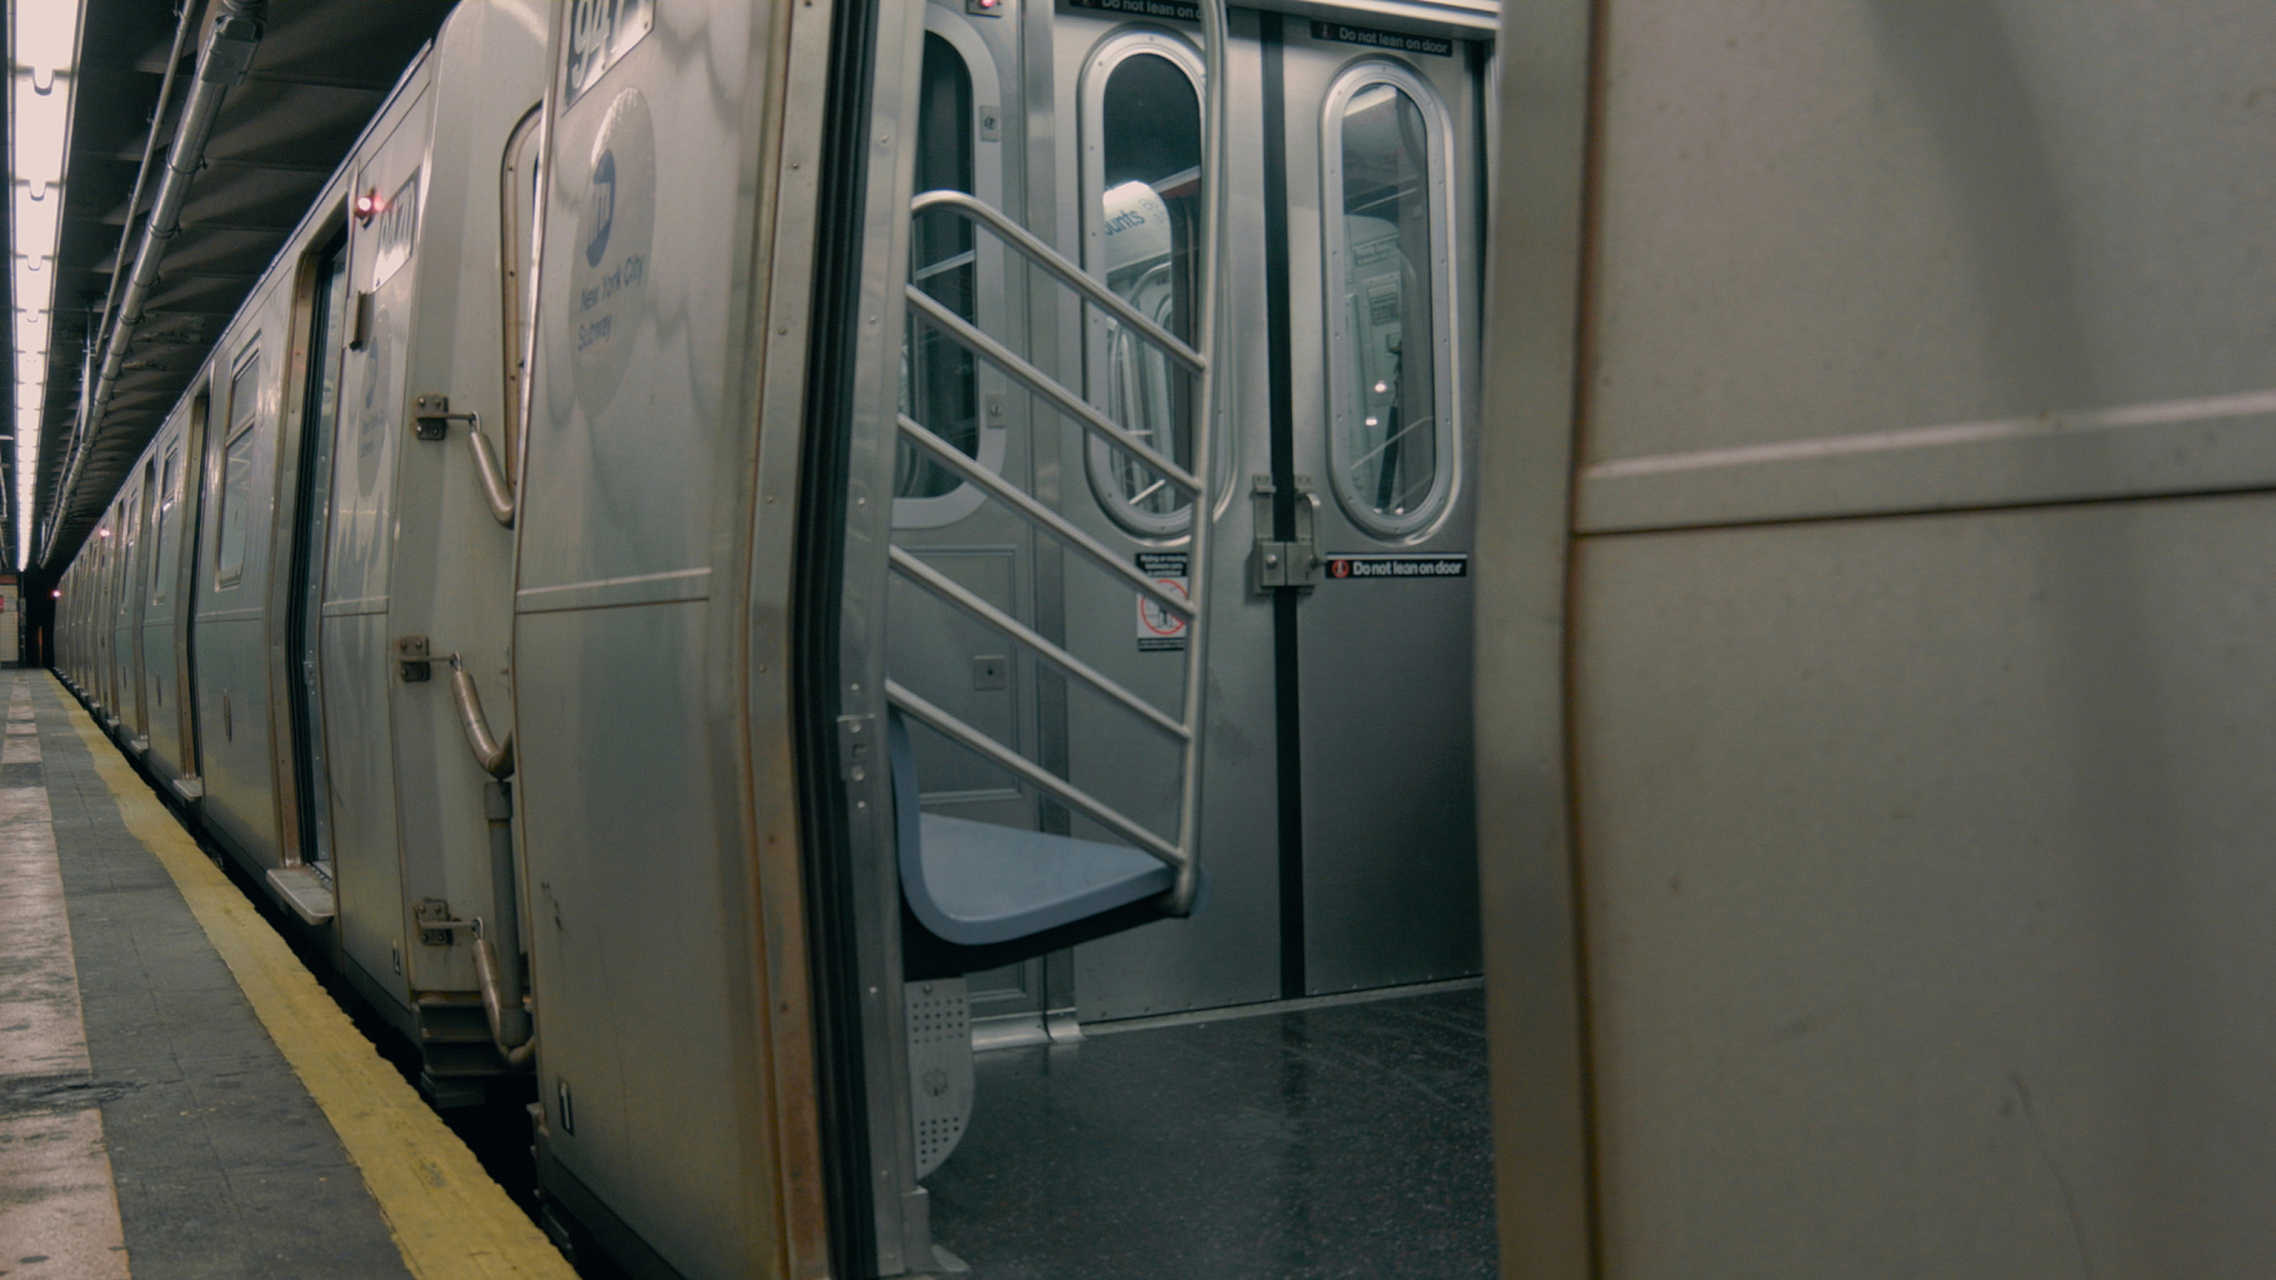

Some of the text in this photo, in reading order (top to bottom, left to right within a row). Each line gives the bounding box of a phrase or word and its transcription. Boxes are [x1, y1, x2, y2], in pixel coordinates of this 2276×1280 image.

[1122, 0, 1145, 12] not
[1146, 1, 1174, 16] lean
[1177, 7, 1194, 18] on
[571, 0, 646, 90] 947
[1340, 27, 1448, 53] Do not lean on door
[1353, 560, 1462, 576] Do not lean on door
